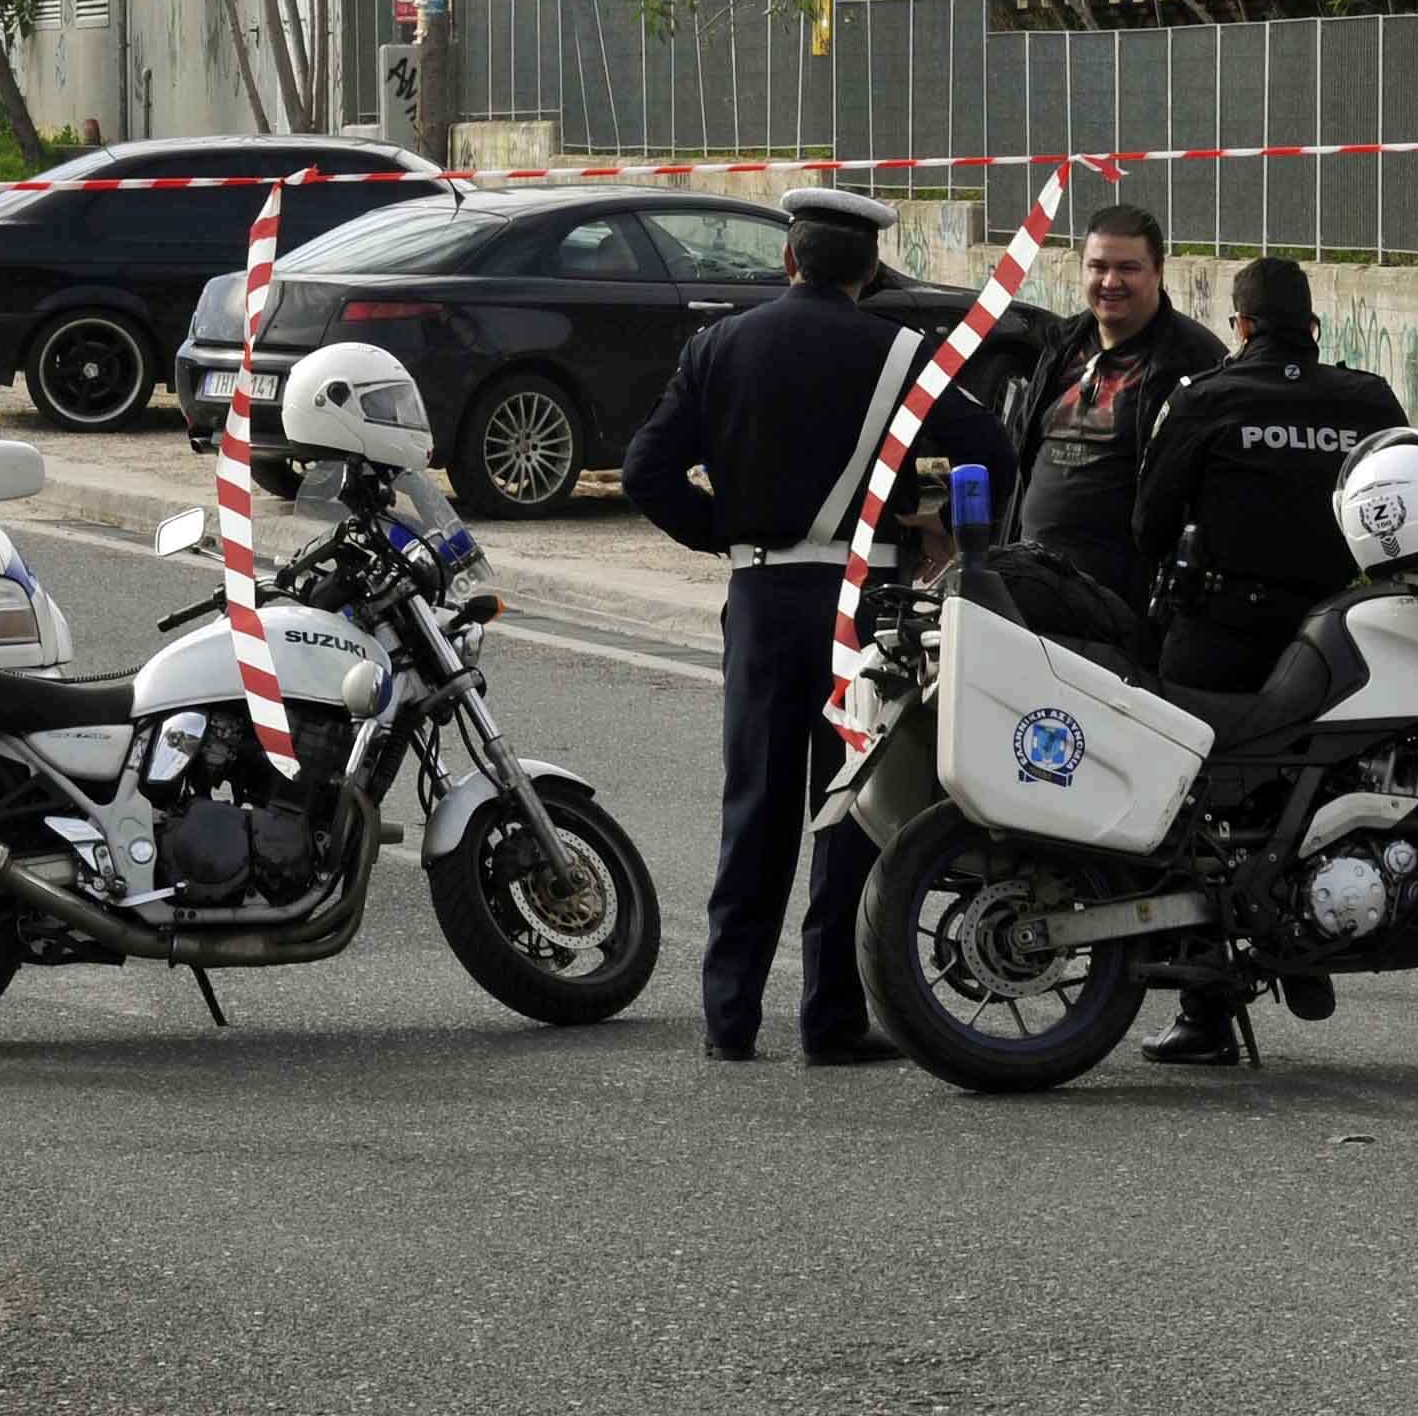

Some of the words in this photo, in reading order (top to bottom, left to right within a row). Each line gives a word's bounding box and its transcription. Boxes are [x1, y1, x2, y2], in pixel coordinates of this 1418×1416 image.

[1241, 426, 1358, 452] POLICE
[1374, 504, 1389, 521] Z
[284, 630, 367, 660] SUZUKI
